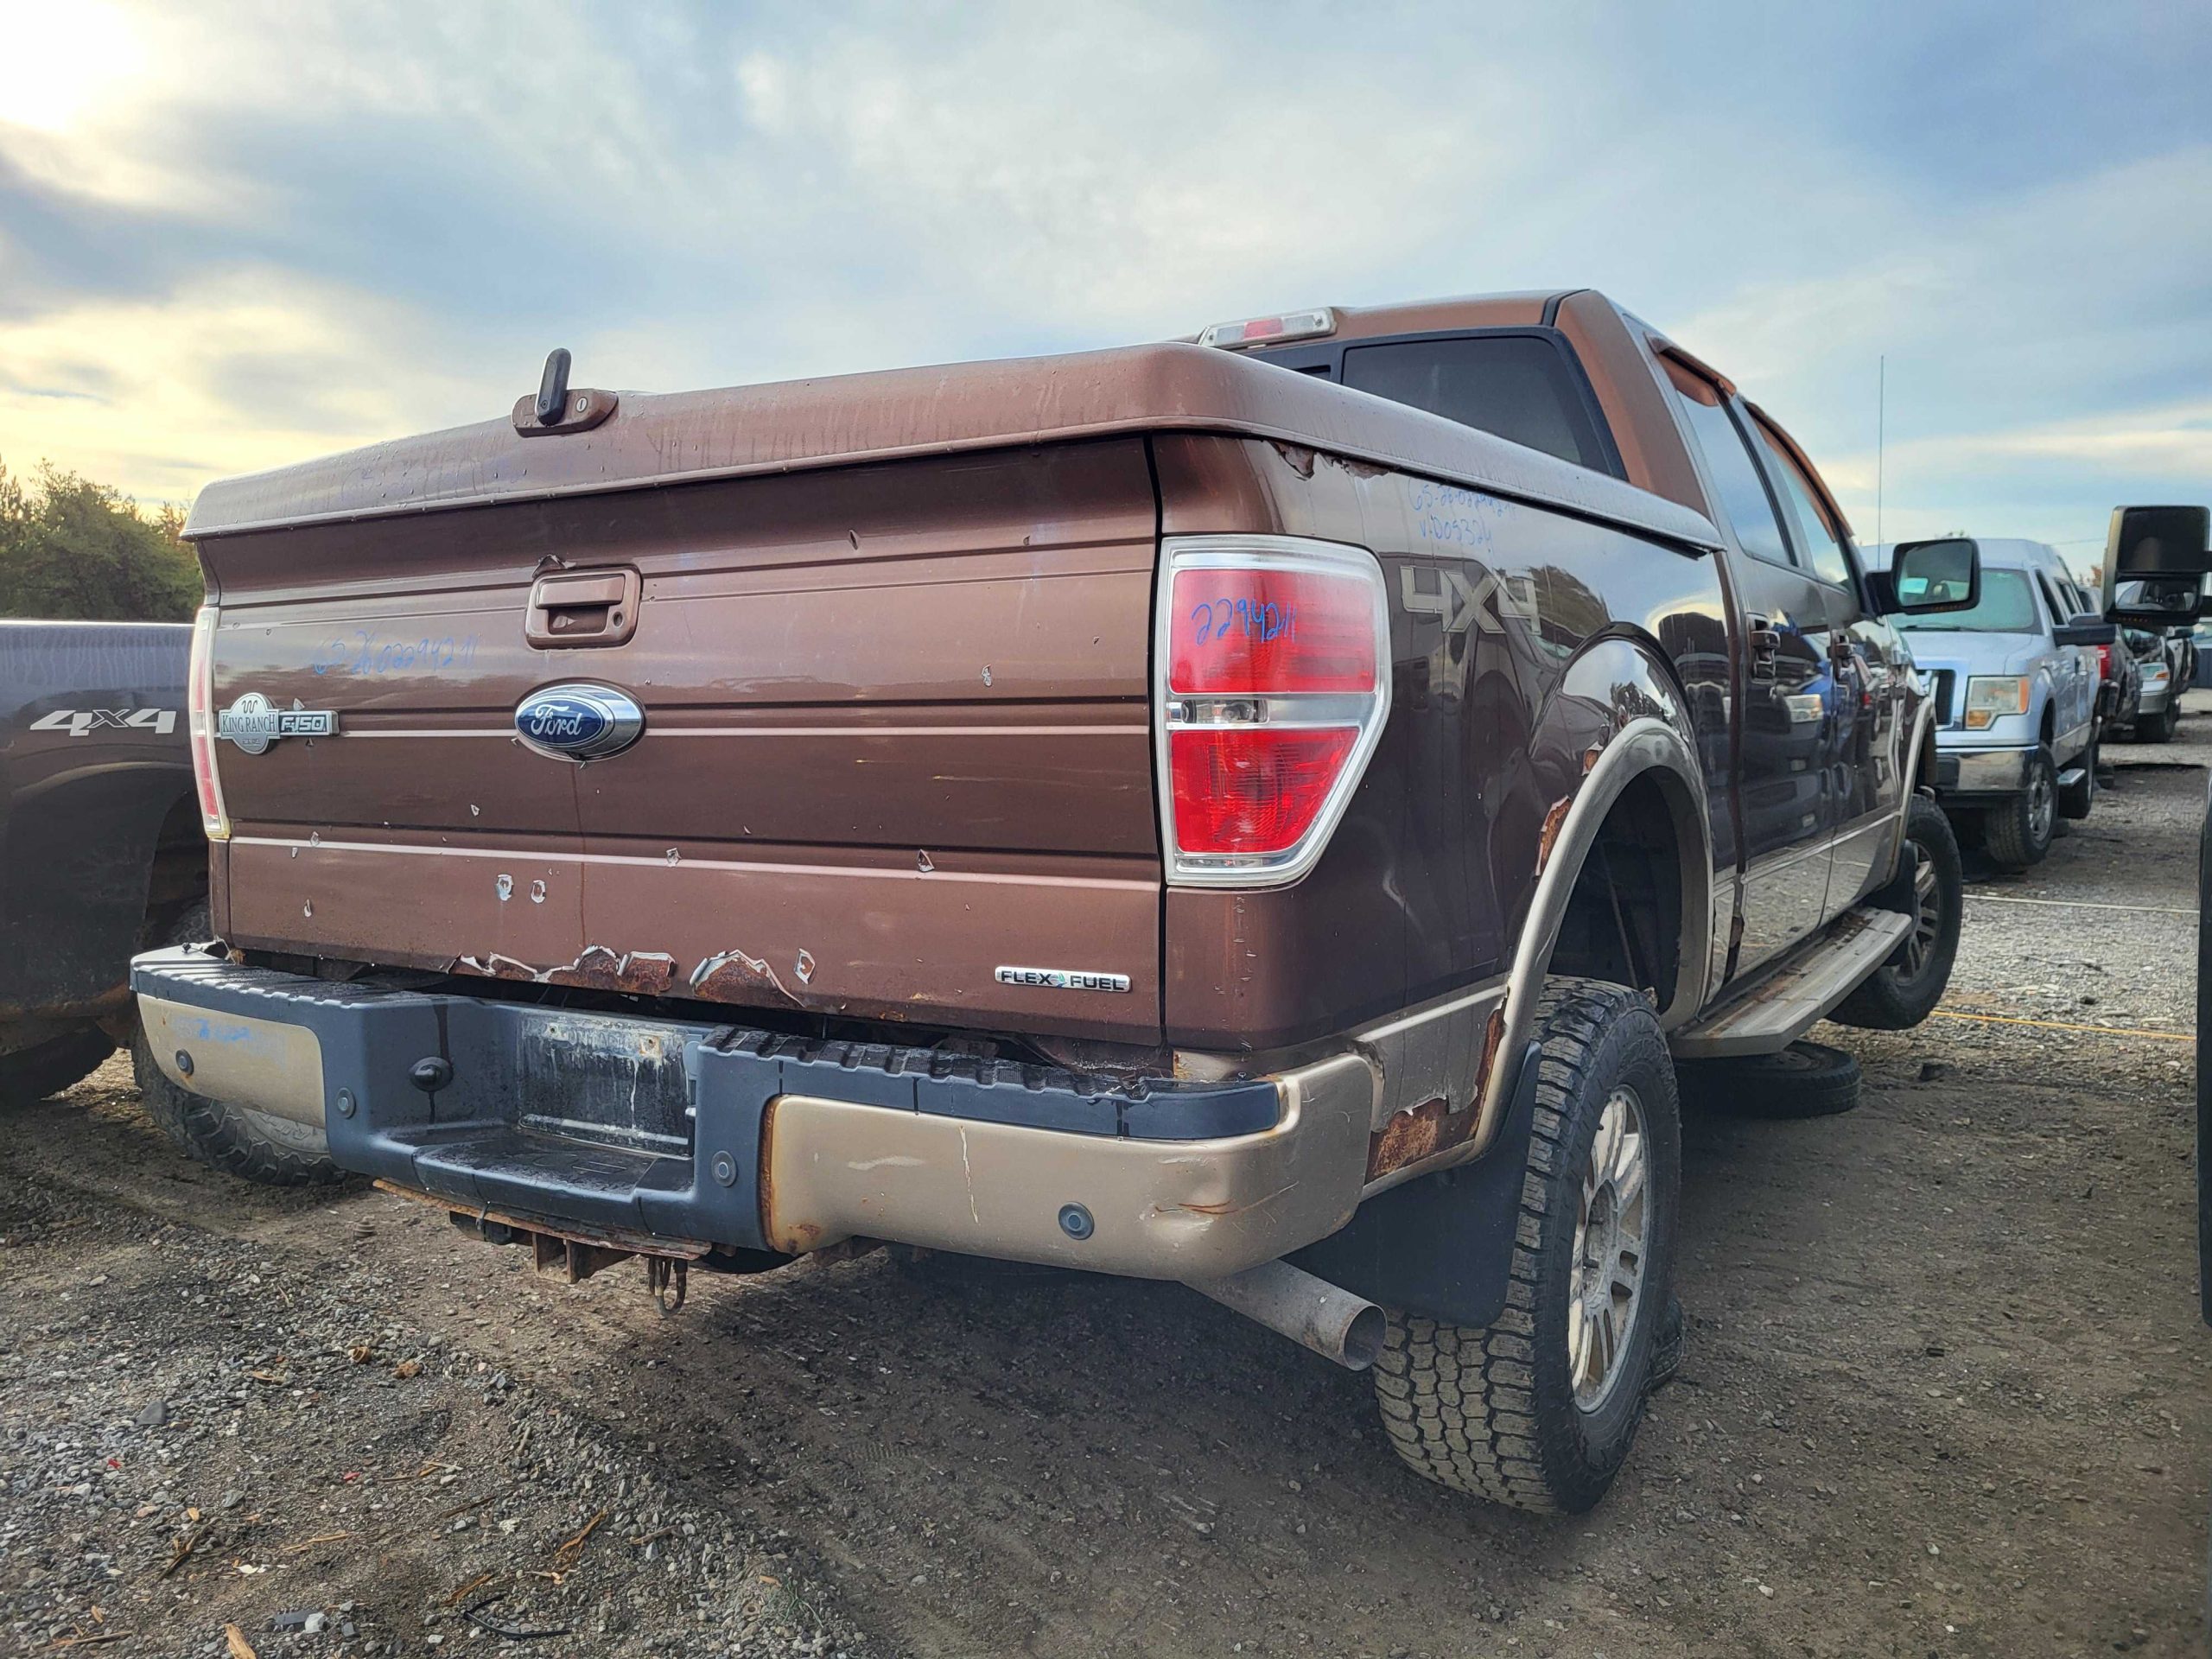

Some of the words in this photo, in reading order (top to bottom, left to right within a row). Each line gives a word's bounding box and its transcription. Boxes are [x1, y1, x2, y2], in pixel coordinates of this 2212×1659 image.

[222, 715, 244, 733] KING
[246, 714, 276, 733] RANCH
[531, 704, 582, 735] Ford
[1001, 970, 1053, 985] FLEX
[1070, 976, 1125, 991] FUEL
